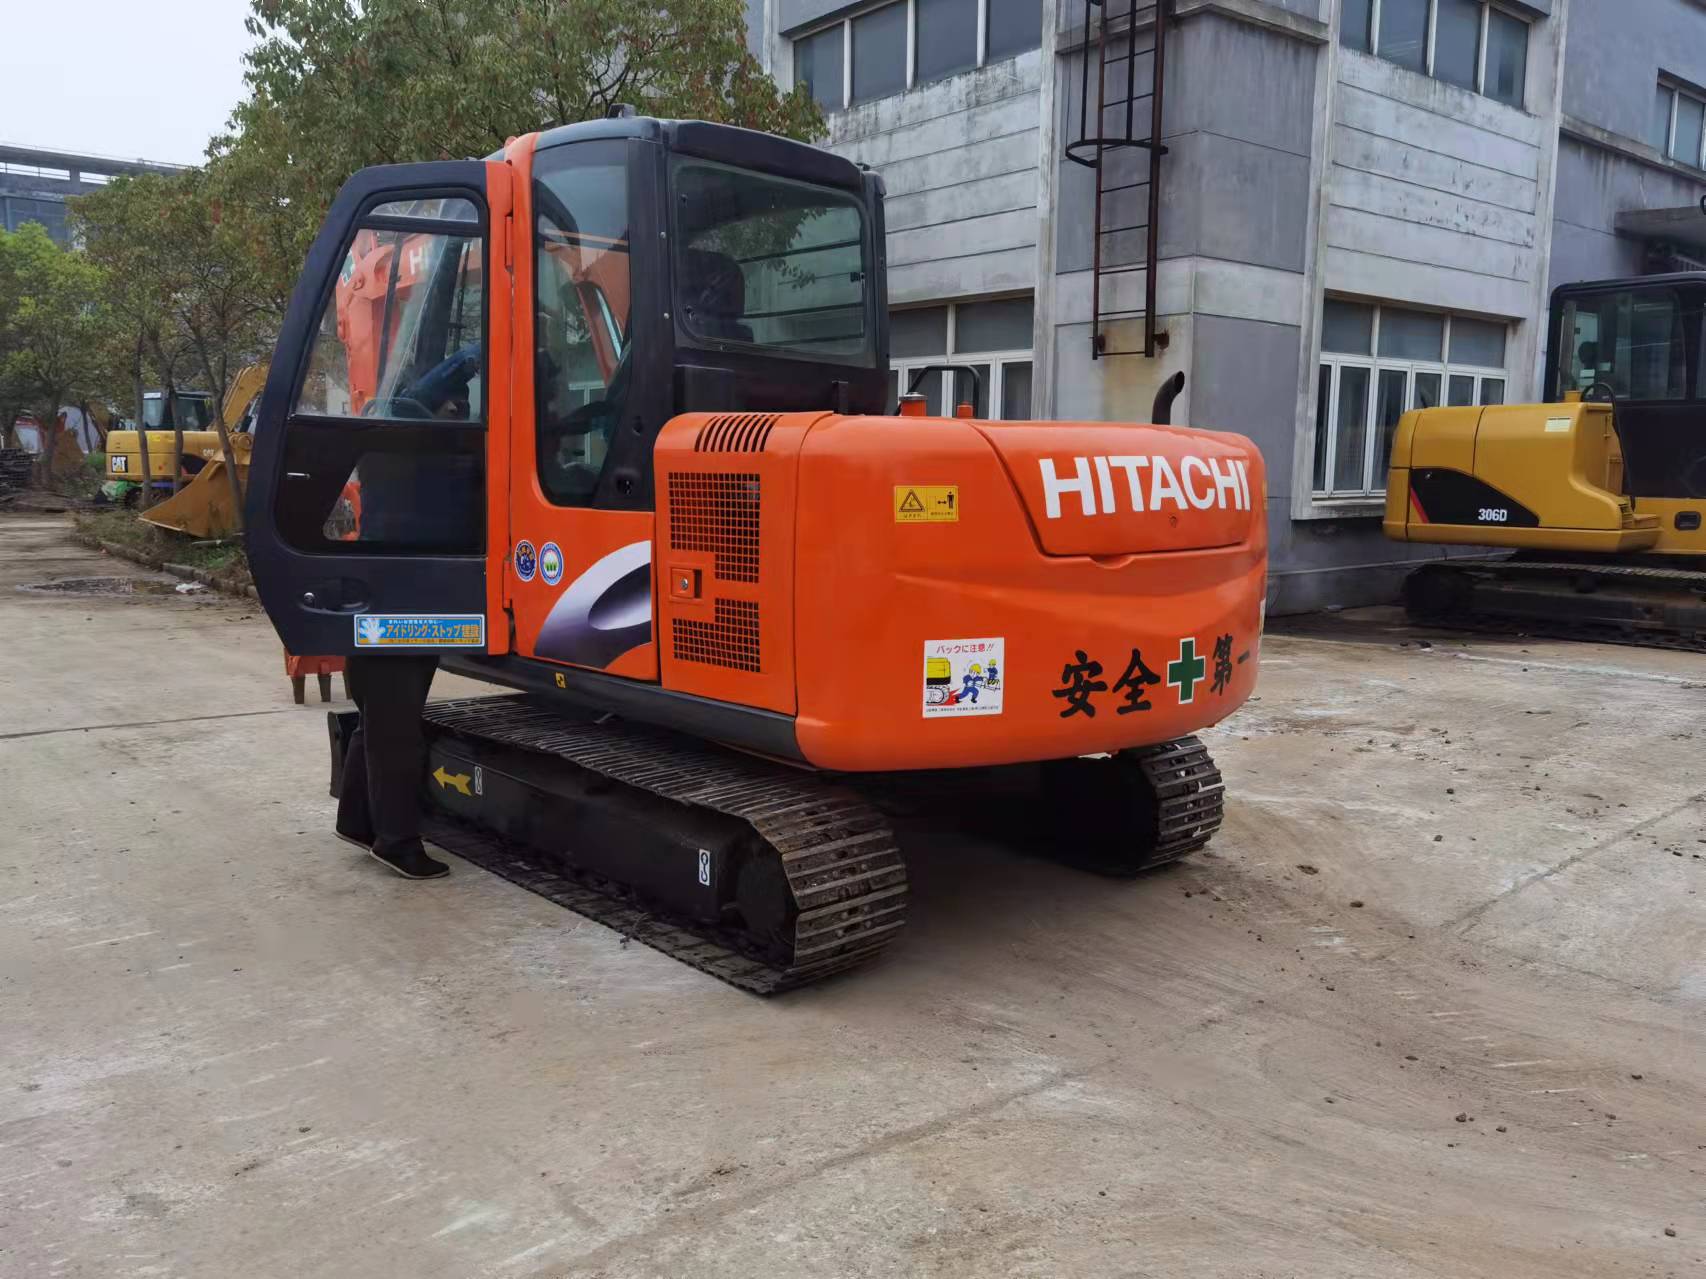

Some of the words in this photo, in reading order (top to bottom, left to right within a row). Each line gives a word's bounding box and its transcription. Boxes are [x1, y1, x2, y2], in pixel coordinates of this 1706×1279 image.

[1039, 455, 1250, 518] HITACHI
[1478, 508, 1508, 522] 306D
[1052, 648, 1161, 718] 安全
[1210, 633, 1250, 696] 第一
